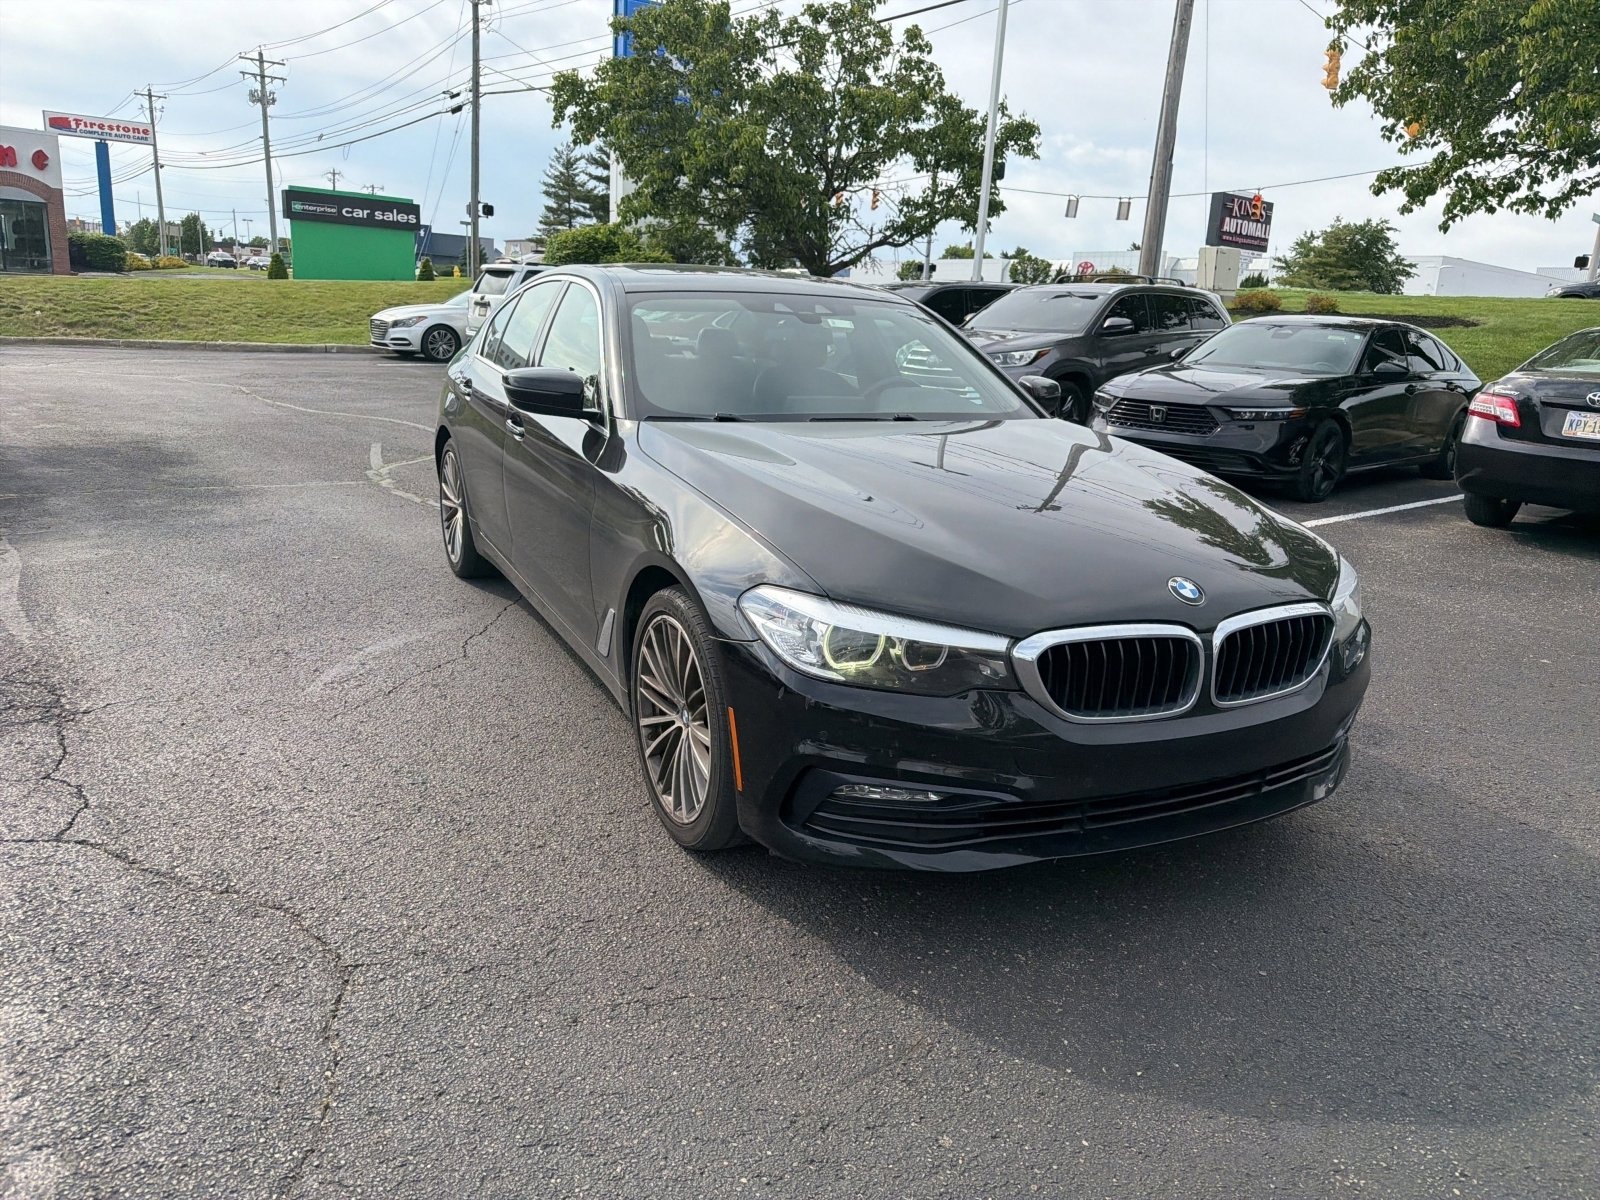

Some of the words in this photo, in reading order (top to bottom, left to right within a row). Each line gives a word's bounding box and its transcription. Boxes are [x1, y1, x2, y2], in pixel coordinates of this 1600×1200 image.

[72, 118, 150, 136] Firestone
[79, 128, 113, 138] COMPLETE
[114, 132, 131, 140] AUTO
[293, 203, 337, 213] enterprise
[341, 207, 371, 219] car
[374, 208, 417, 224] sales
[1232, 198, 1267, 222] KINS
[1221, 216, 1270, 239] AUTOMALL
